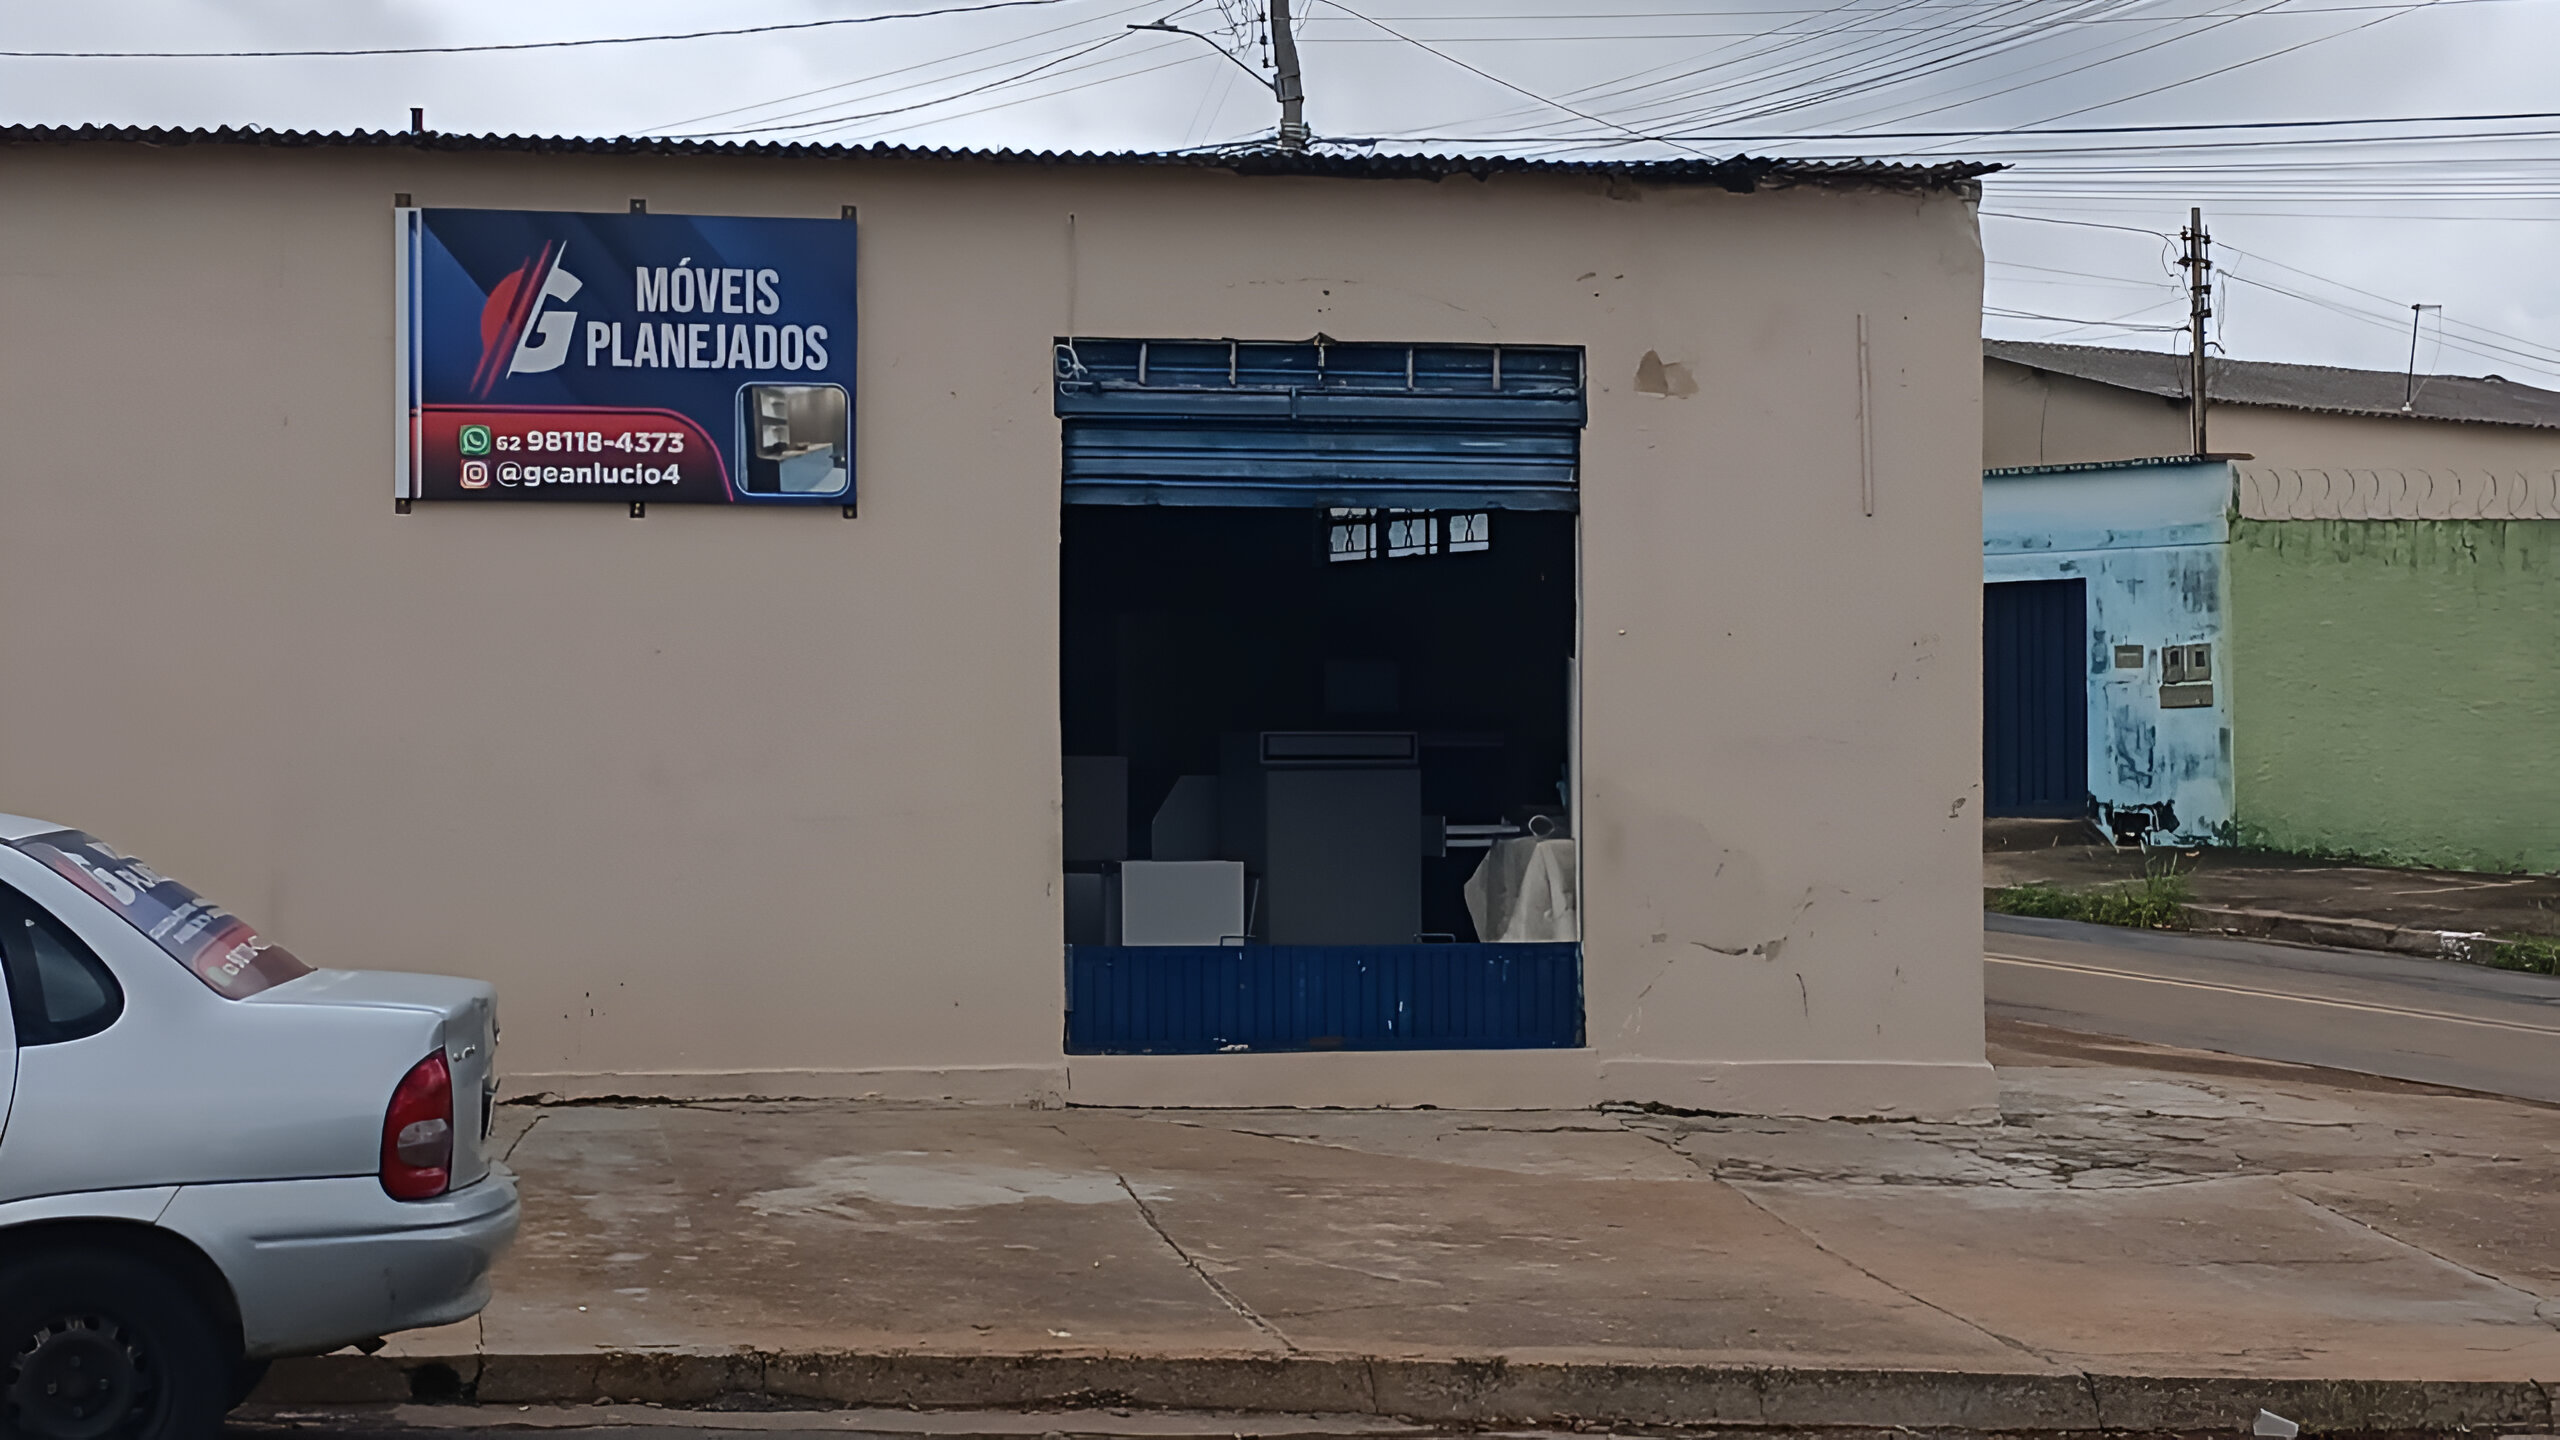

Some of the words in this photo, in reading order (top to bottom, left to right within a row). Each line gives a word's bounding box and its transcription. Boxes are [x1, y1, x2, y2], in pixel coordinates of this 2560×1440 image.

[636, 257, 780, 315] MÓVEIS
[587, 321, 828, 371] PLANEJADOS
[496, 436, 521, 451] 62
[527, 430, 684, 453] 98118-4373
[496, 461, 680, 487] @geanlucio4
